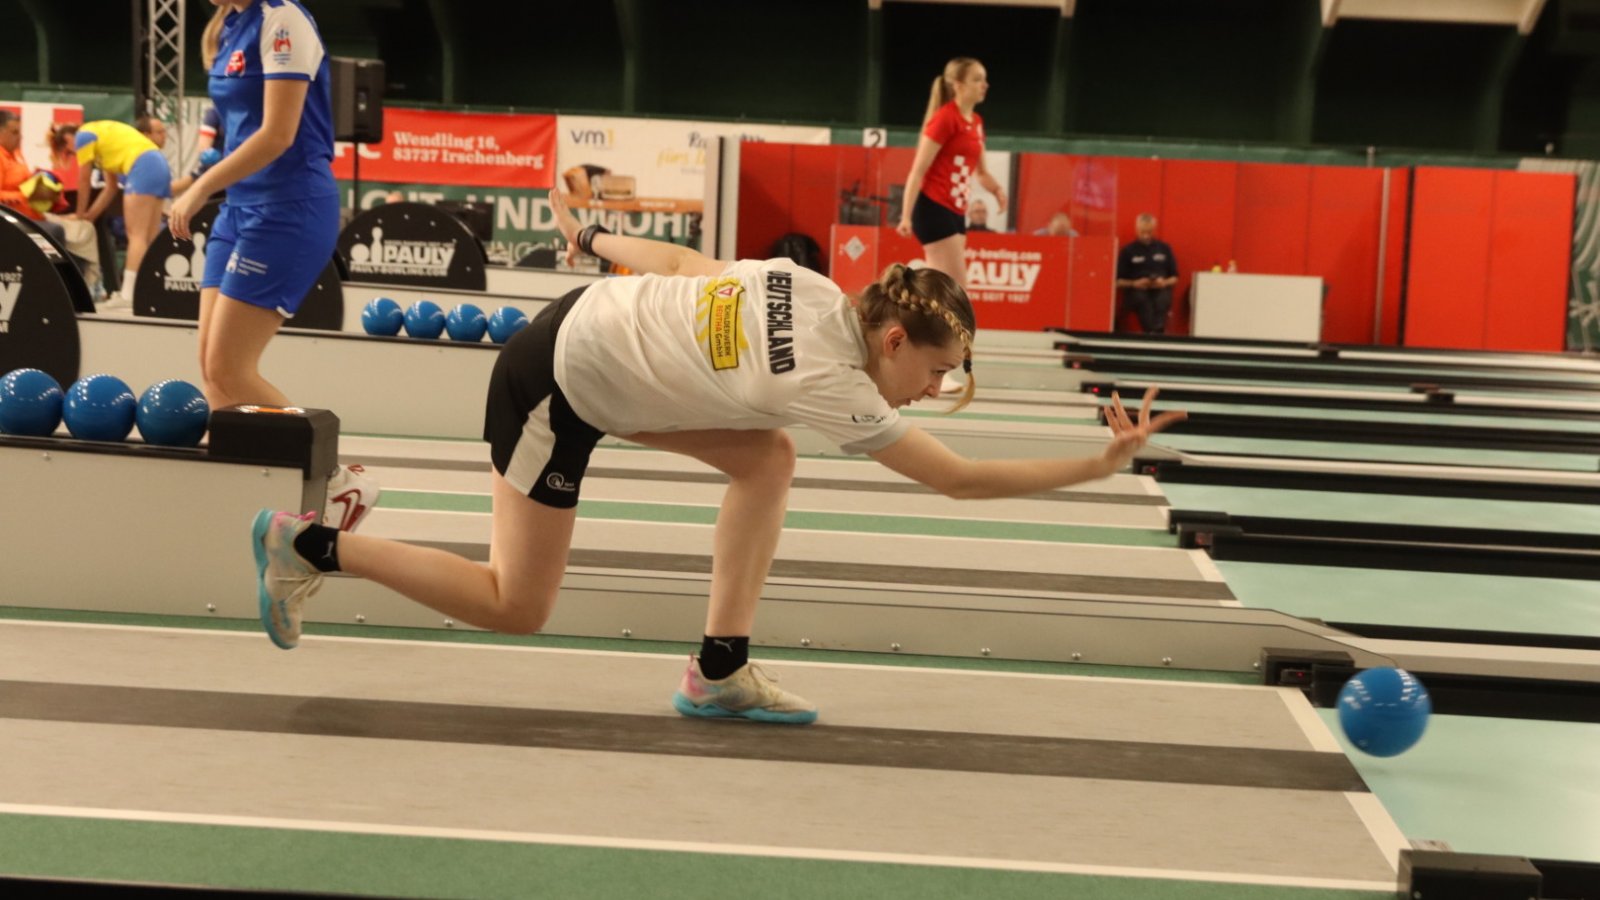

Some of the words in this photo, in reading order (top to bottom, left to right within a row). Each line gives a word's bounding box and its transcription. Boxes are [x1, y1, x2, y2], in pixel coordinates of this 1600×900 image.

[394, 131, 474, 151] Wendling
[478, 136, 500, 151] 16,
[393, 147, 439, 161] 83737
[441, 149, 545, 170] Irschenberg
[384, 244, 456, 267] PAULY
[965, 261, 1042, 291] AULY
[723, 304, 732, 357] SCHILDERWERK
[766, 270, 796, 375] DEUTSCHLAND
